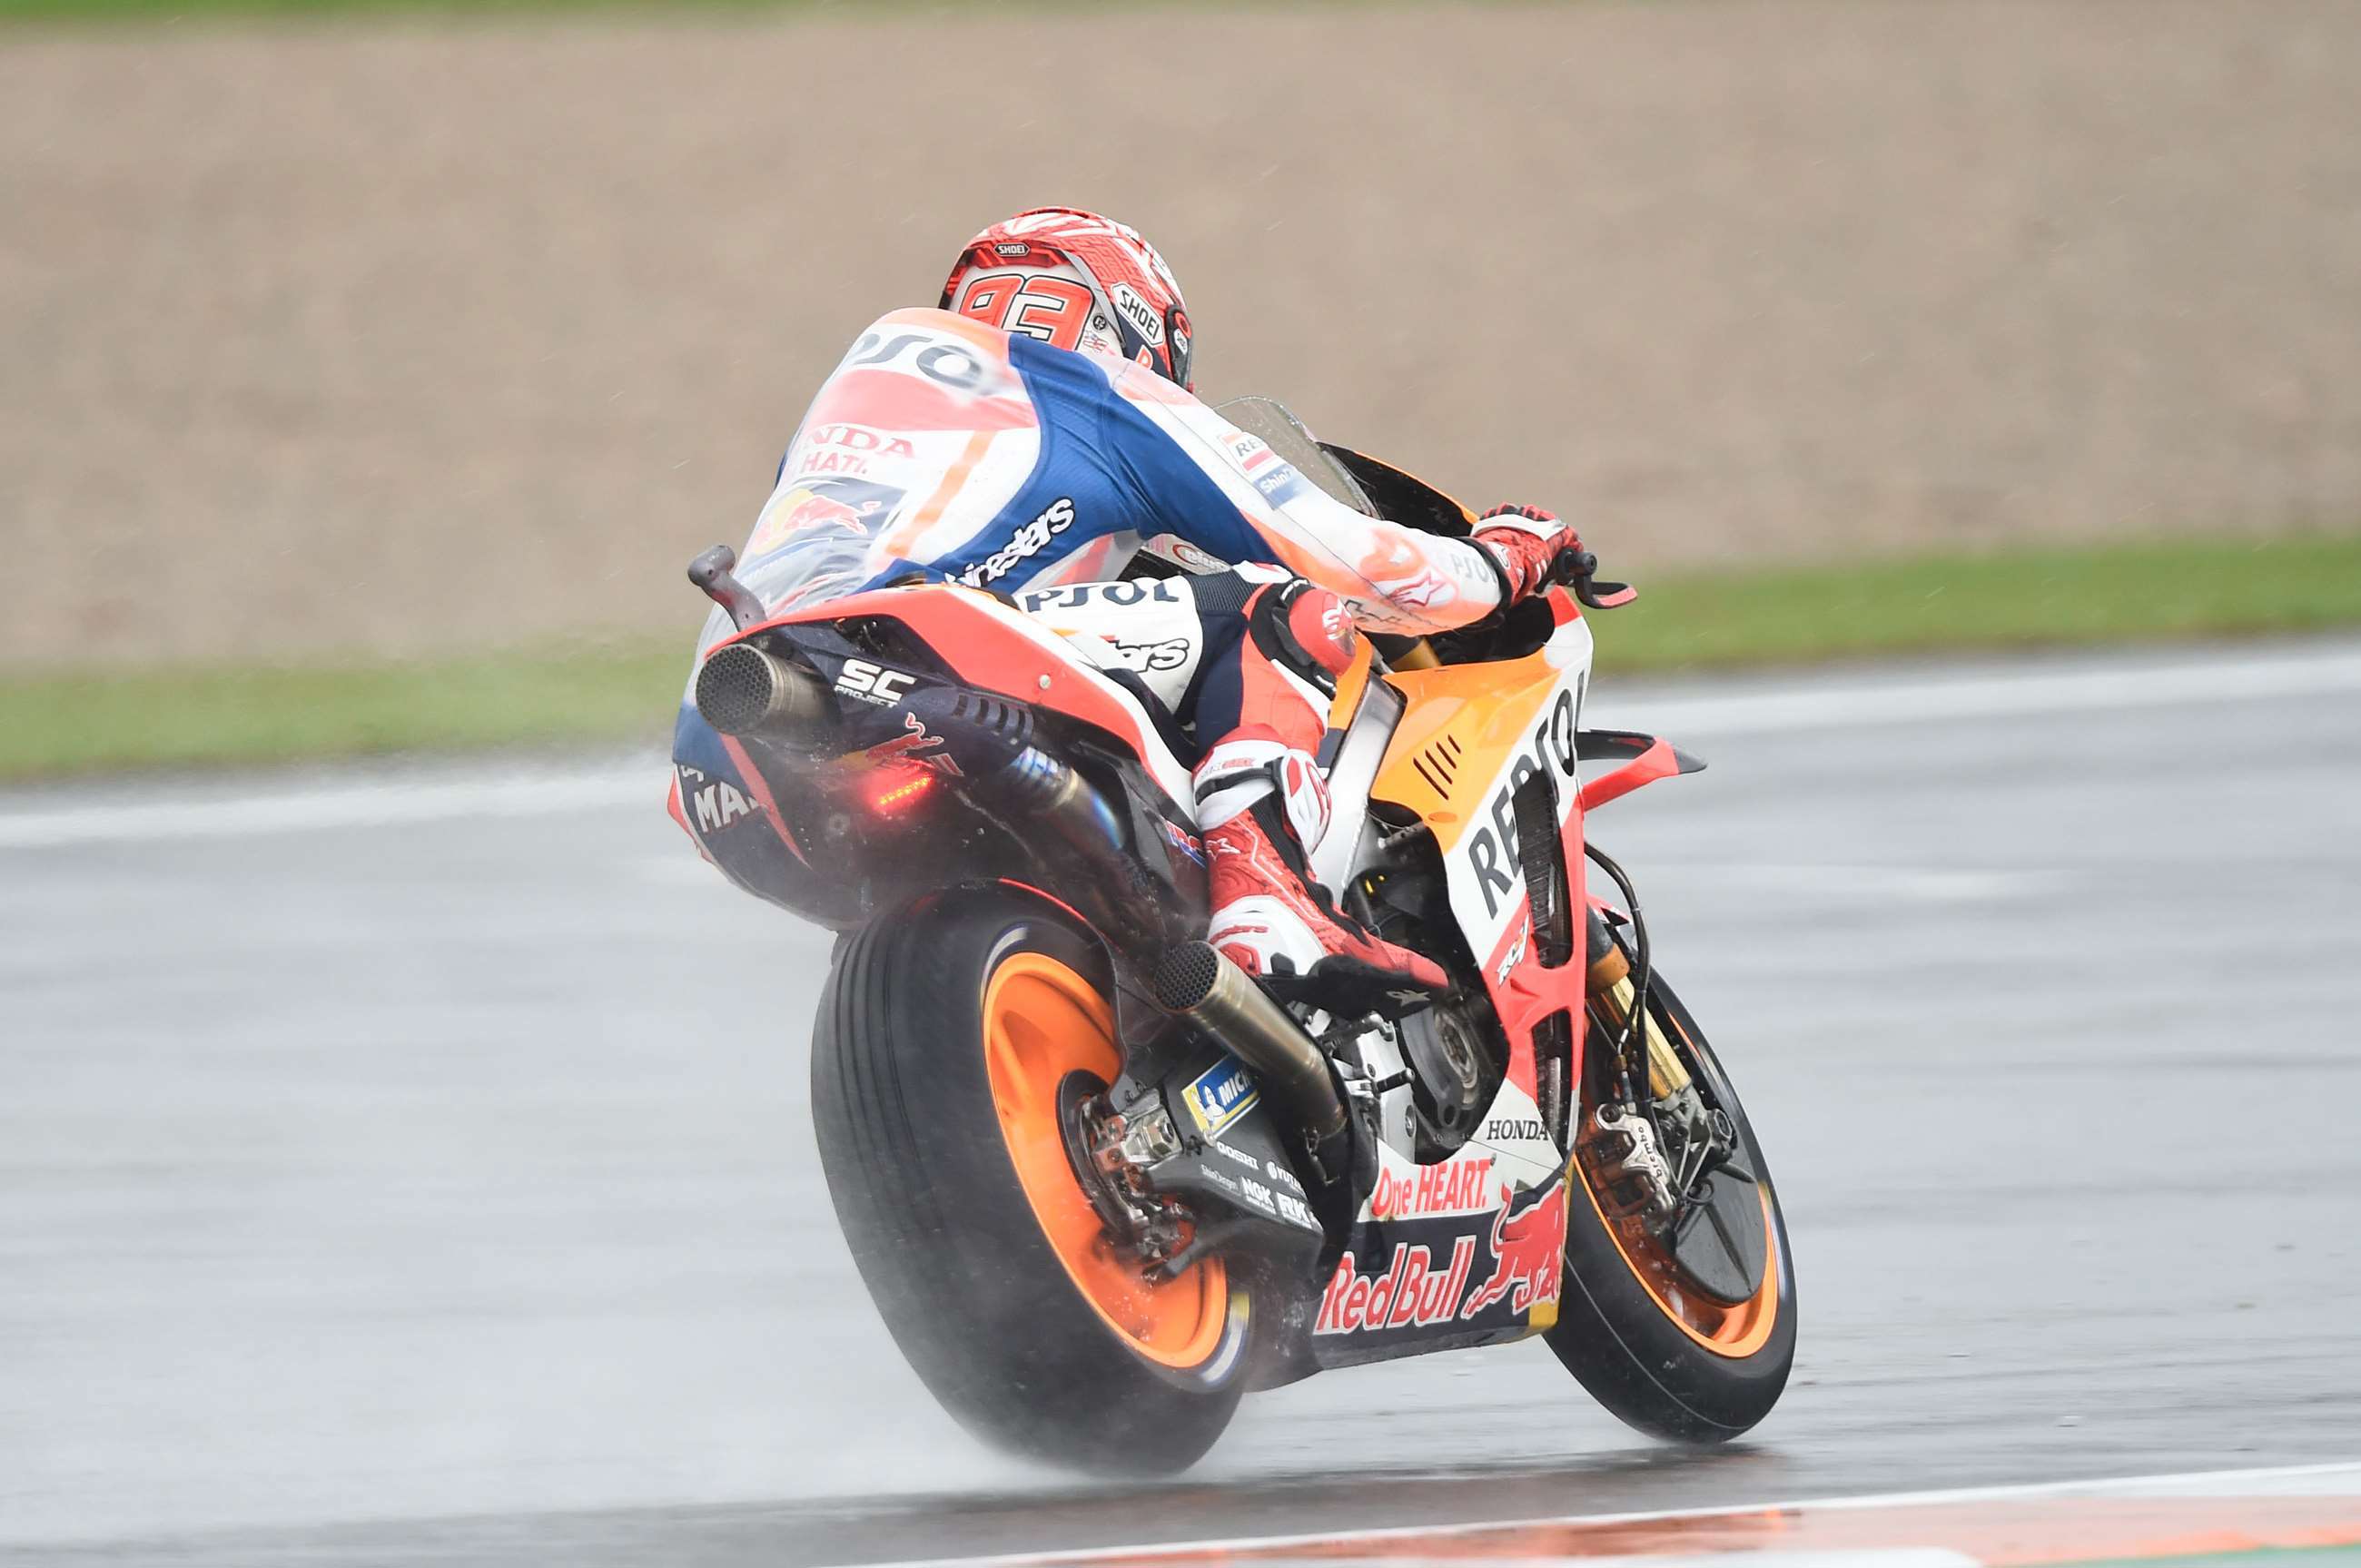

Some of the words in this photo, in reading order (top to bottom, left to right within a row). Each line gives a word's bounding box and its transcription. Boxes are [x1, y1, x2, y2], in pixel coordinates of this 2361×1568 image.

[997, 244, 1026, 255] SHOEI
[959, 273, 1095, 352] 93
[1119, 289, 1161, 340] SHOEI
[943, 496, 1076, 588] inestars
[834, 684, 898, 709] PROJECT
[836, 657, 918, 702] SC
[1487, 1119, 1549, 1141] HONDA
[1638, 1126, 1663, 1178] brembo
[1240, 1175, 1275, 1208] NGK
[1371, 1167, 1412, 1218] One
